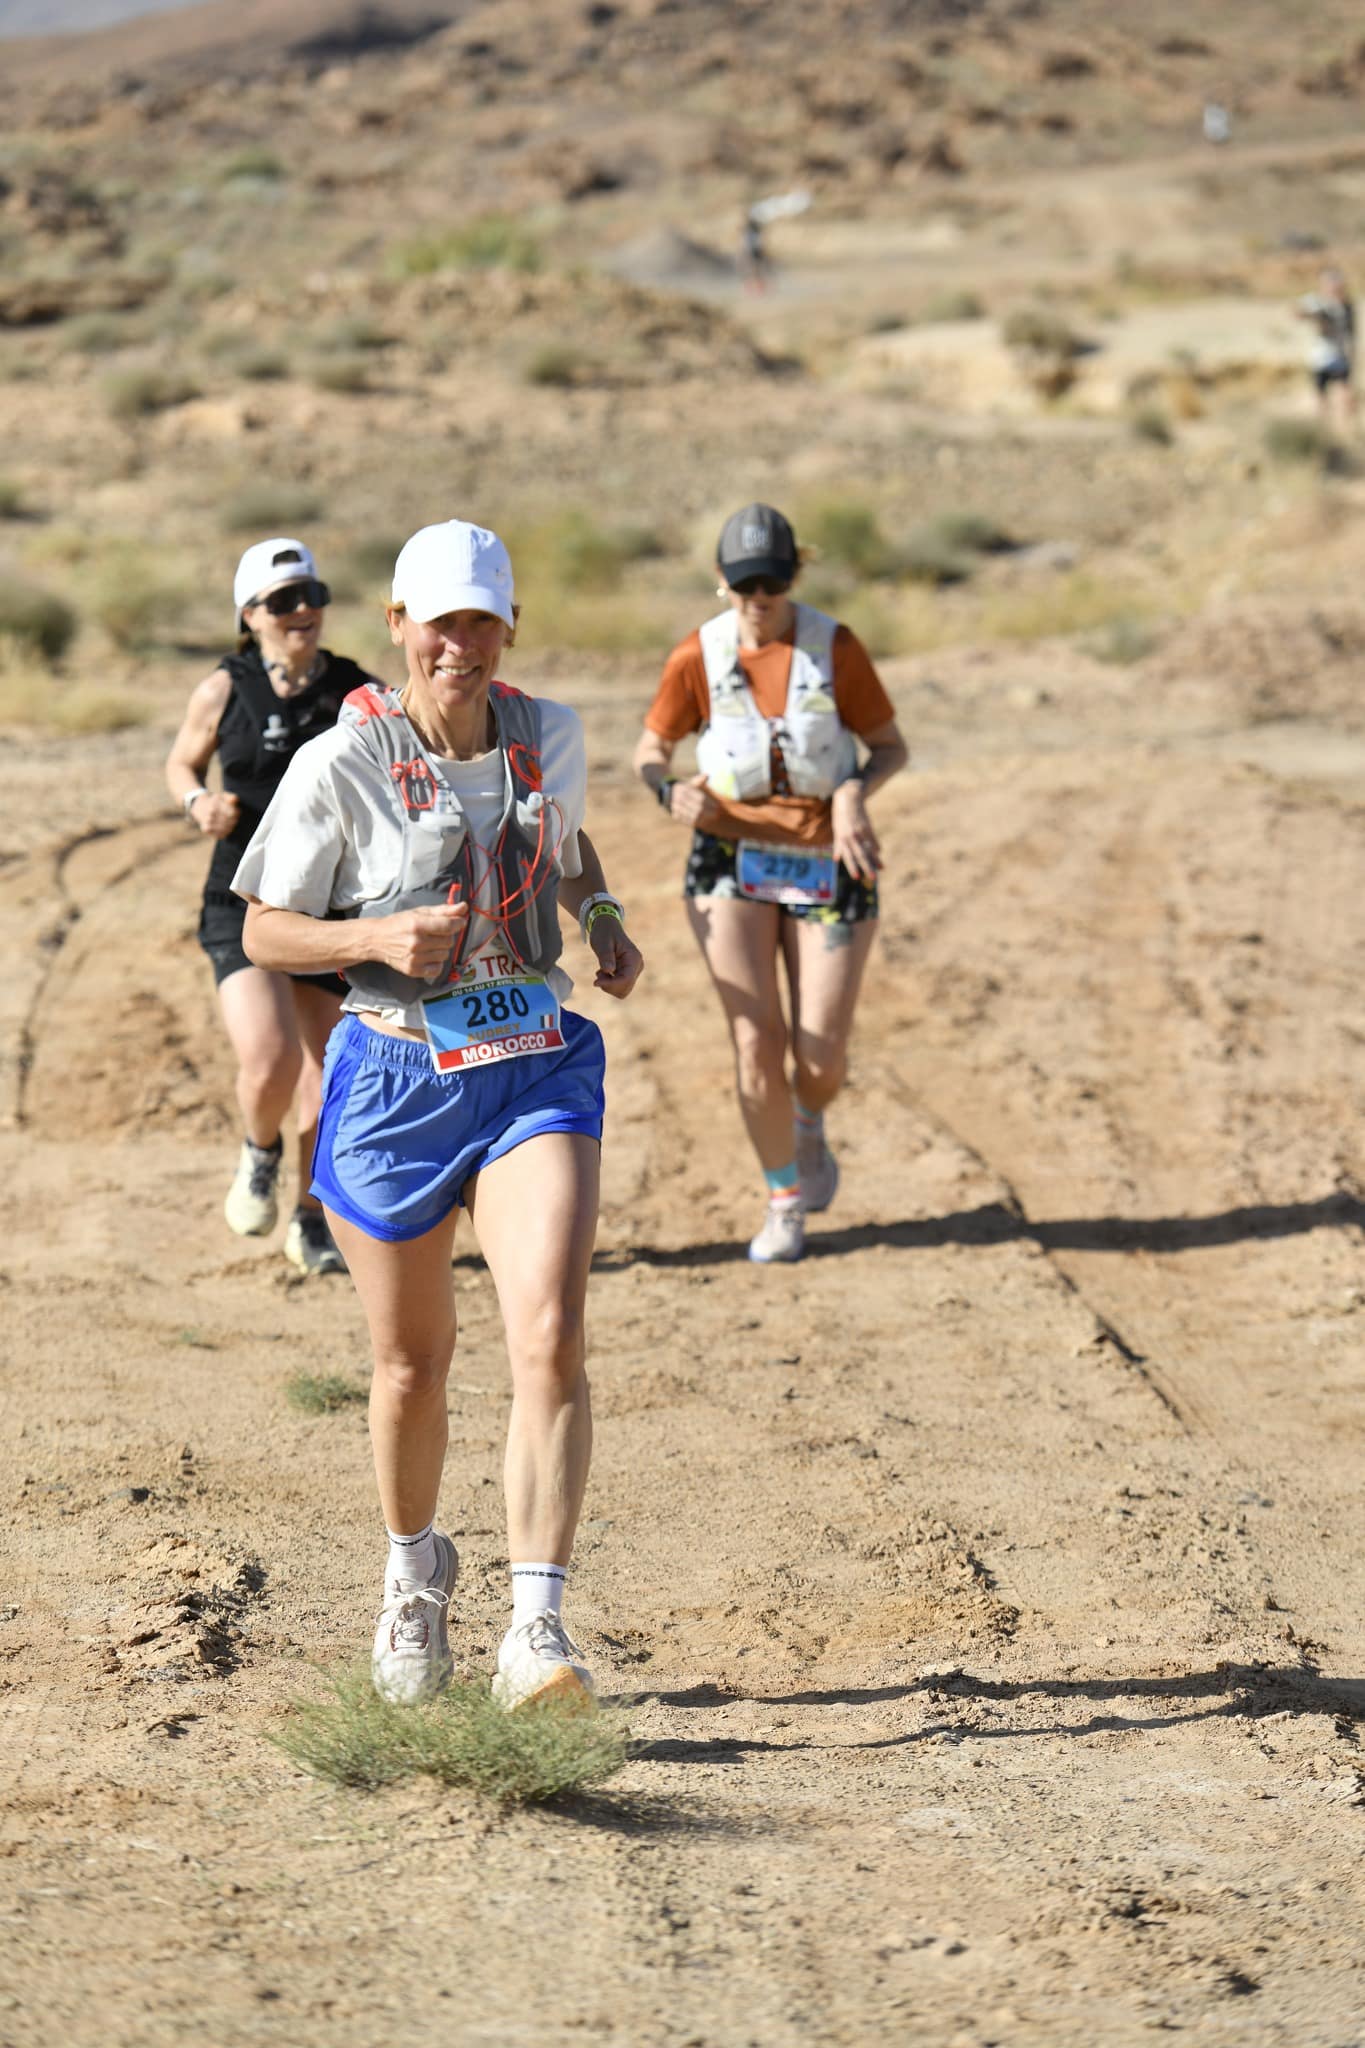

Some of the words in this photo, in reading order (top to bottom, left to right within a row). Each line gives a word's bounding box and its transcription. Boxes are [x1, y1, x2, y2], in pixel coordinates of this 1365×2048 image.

[764, 855, 811, 879] 279
[462, 987, 529, 1028] 280
[461, 1033, 546, 1064] MOROCCO
